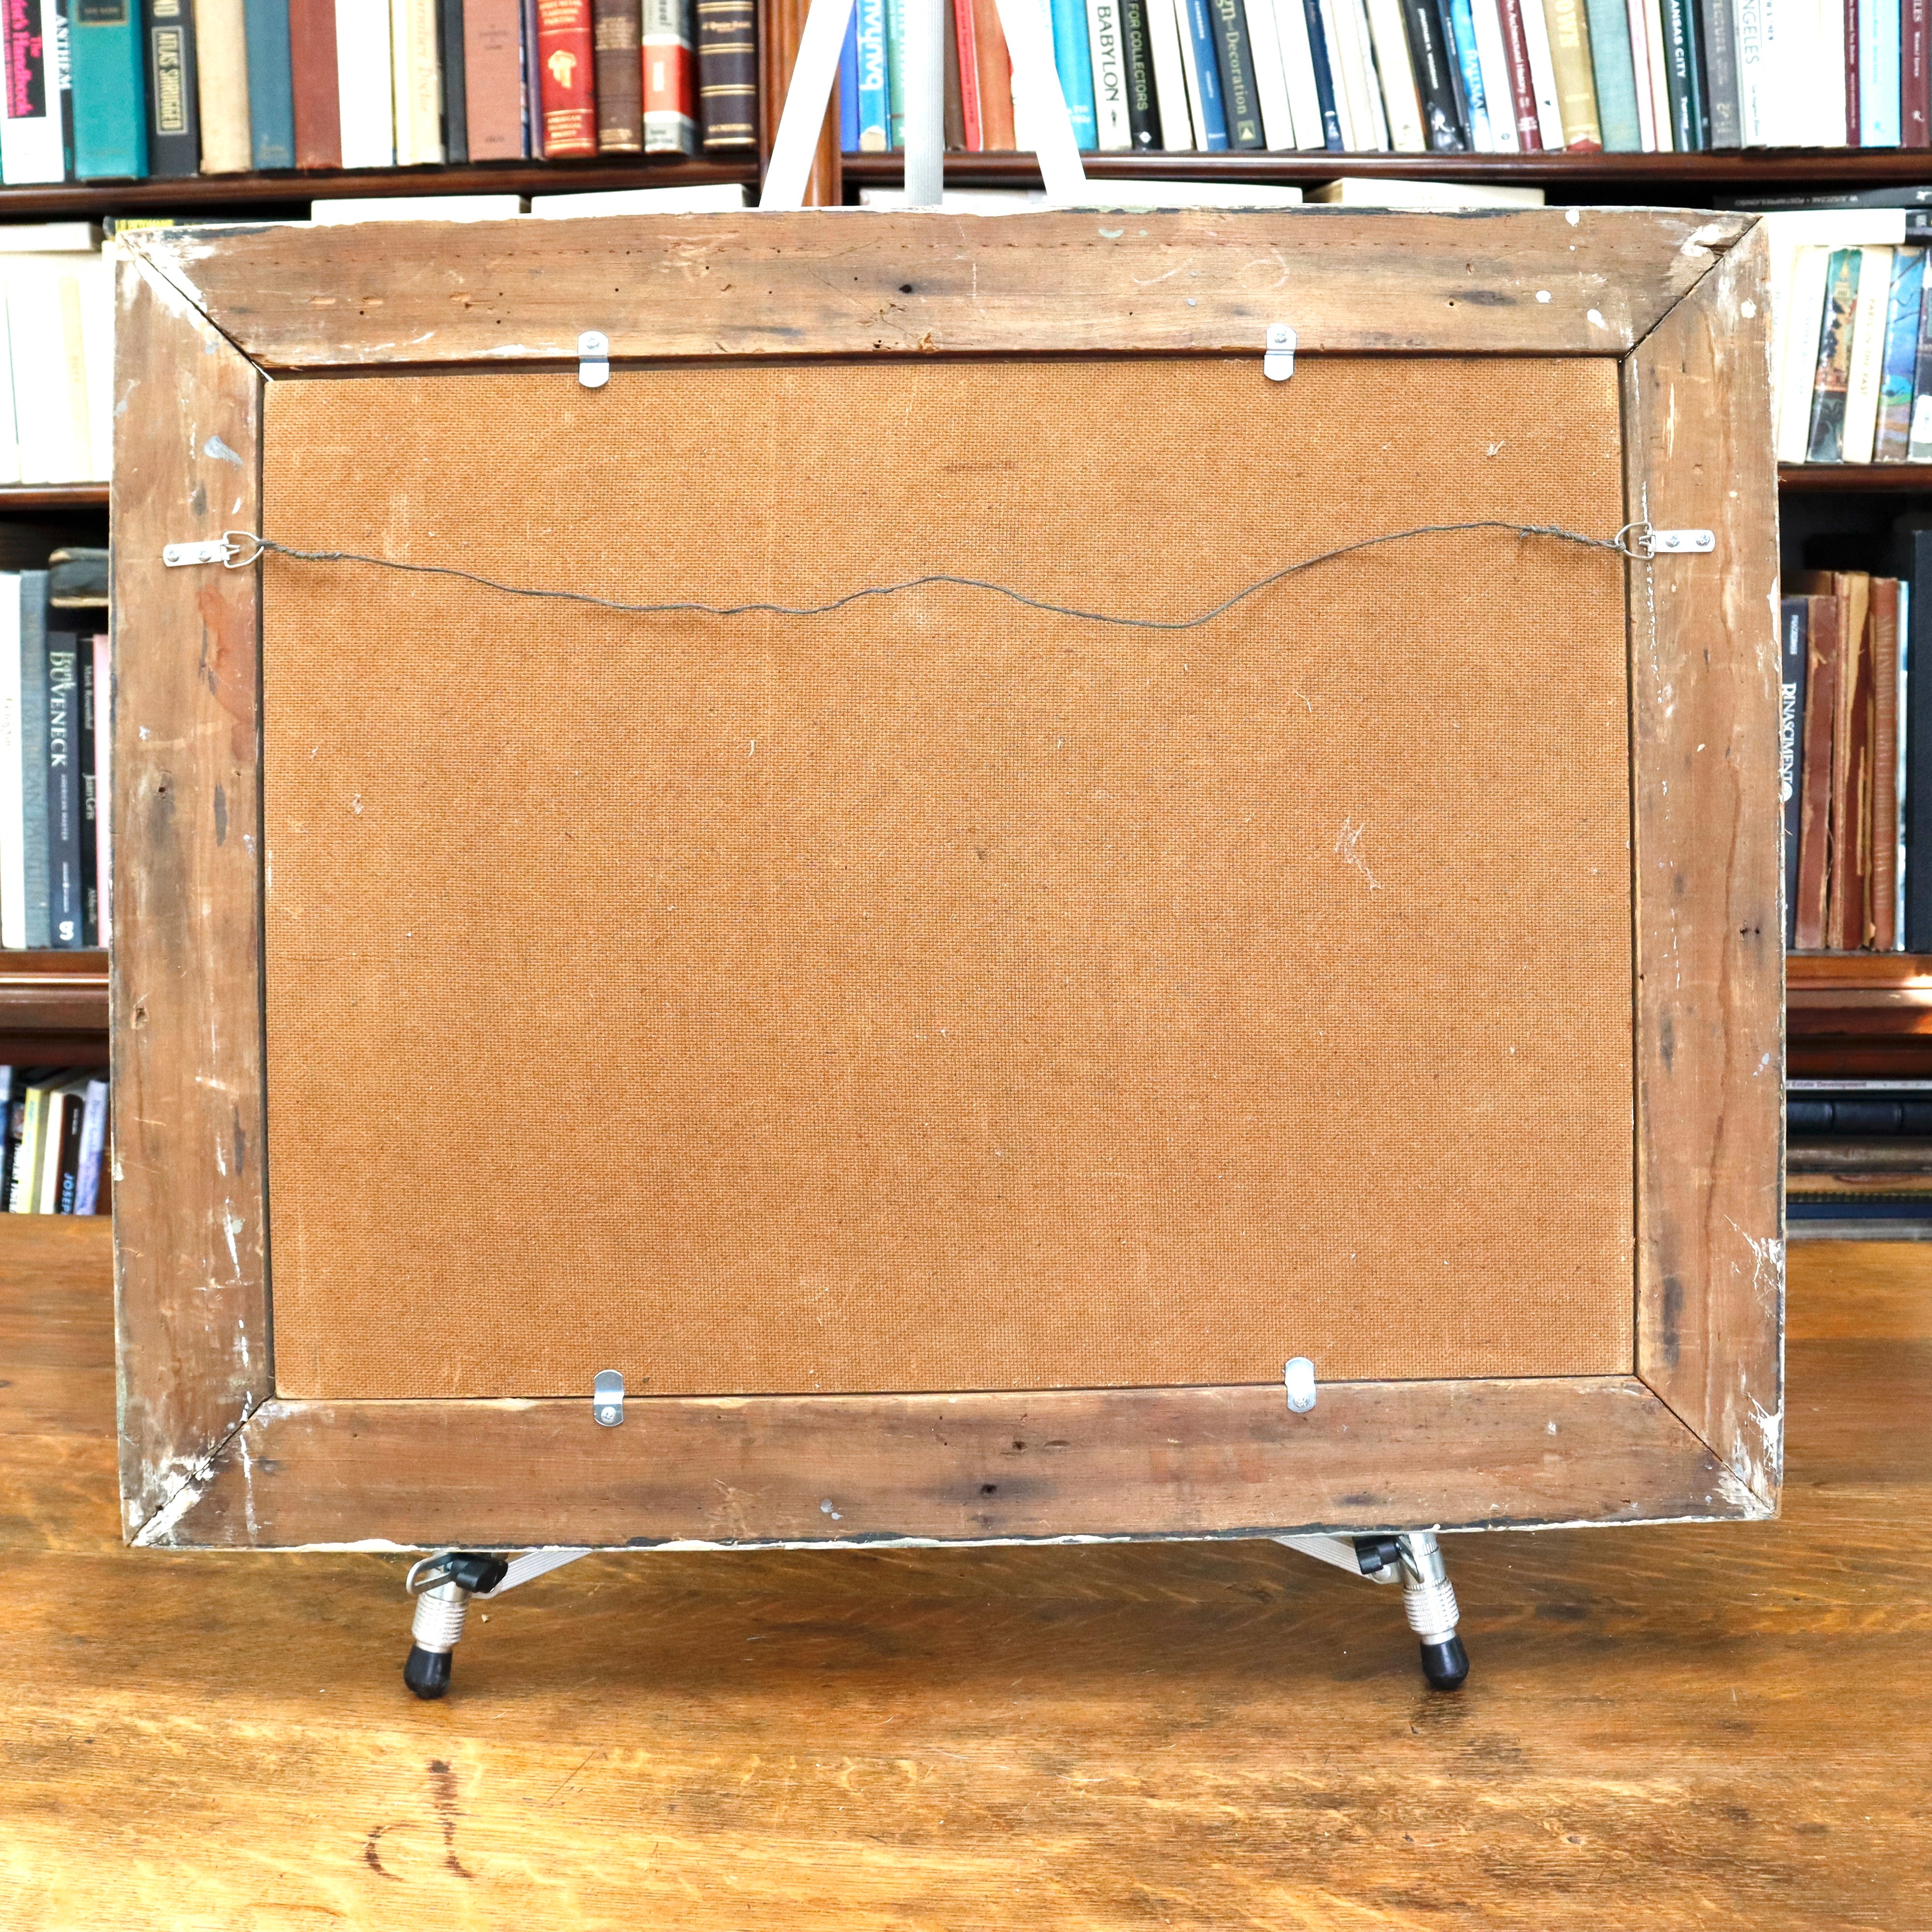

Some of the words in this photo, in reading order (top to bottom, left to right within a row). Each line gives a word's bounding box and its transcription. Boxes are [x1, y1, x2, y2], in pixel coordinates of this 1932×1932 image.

[858, 0, 884, 91] bauhau
[1128, 3, 1141, 28] FOR
[1742, 0, 1760, 64] NGELES
[56, 14, 71, 90] ANTHEM
[157, 32, 179, 67] ATLAS
[1097, 6, 1120, 101] BABYLON
[1130, 30, 1149, 111] COLLECTORS
[1675, 48, 1686, 78] CITY
[159, 69, 182, 130] SHRUGGED
[50, 652, 68, 767] DUVENECK
[61, 1172, 75, 1214] JOSEP
